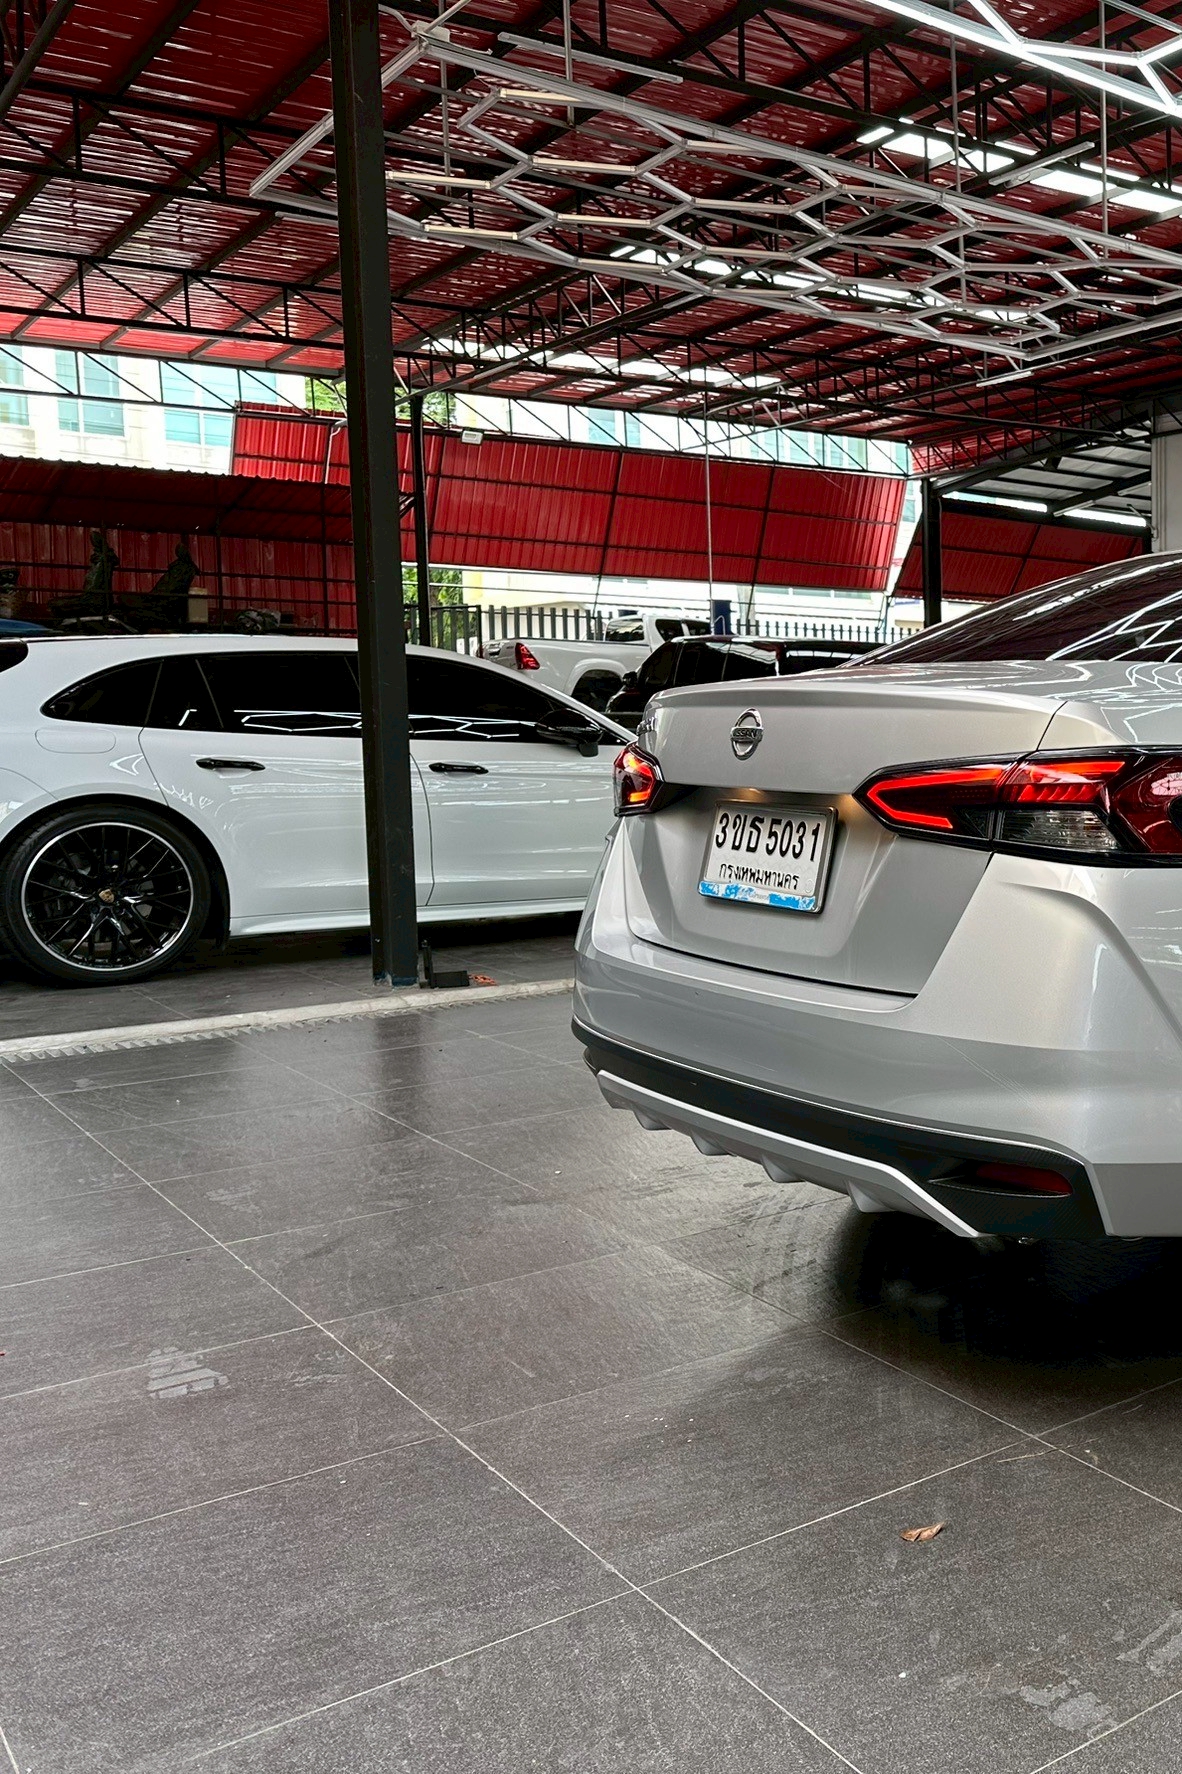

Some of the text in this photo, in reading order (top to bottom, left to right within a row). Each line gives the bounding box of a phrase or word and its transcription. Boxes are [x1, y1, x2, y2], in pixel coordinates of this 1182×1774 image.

[715, 812, 820, 862] 3ขธ 5031
[719, 863, 800, 891] กรุงเทพมหานคร
